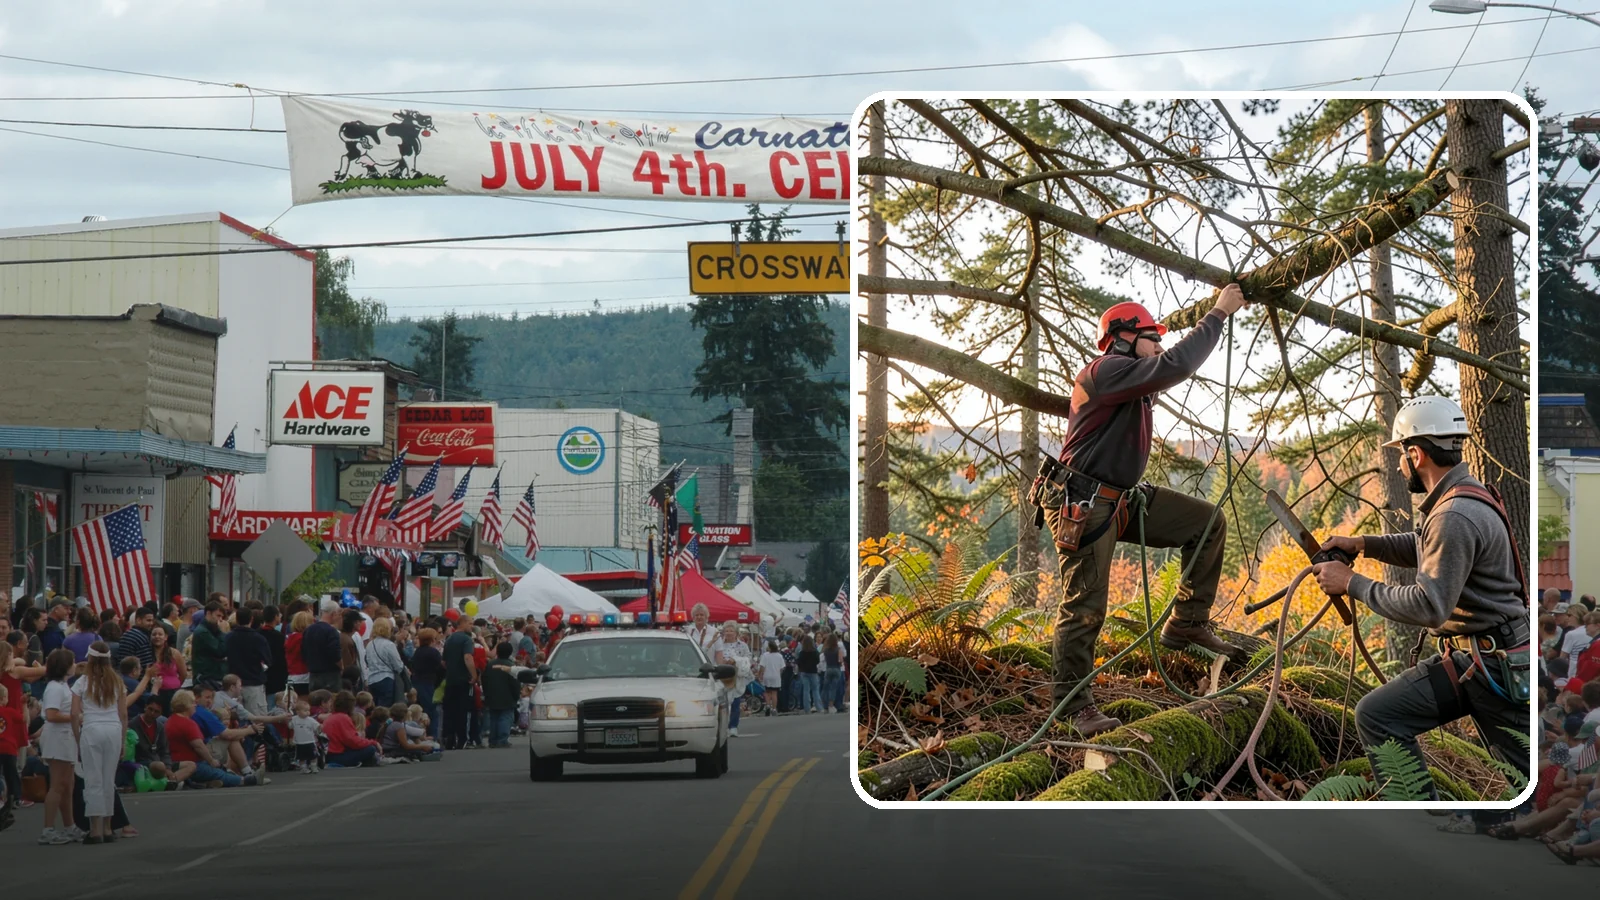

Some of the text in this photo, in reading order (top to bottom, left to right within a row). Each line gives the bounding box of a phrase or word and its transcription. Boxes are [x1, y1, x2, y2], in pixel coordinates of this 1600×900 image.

[694, 121, 850, 149] Carnat
[481, 141, 604, 192] JULY
[632, 150, 746, 198] 4th.
[697, 254, 850, 280] CROSSWA
[283, 380, 373, 420] ACE
[405, 409, 452, 422] CEDAR
[283, 421, 371, 436] Hardware
[83, 485, 155, 495] St. Vincent de Paul
[688, 526, 741, 534] CRNATION
[699, 535, 730, 543] GLASS
